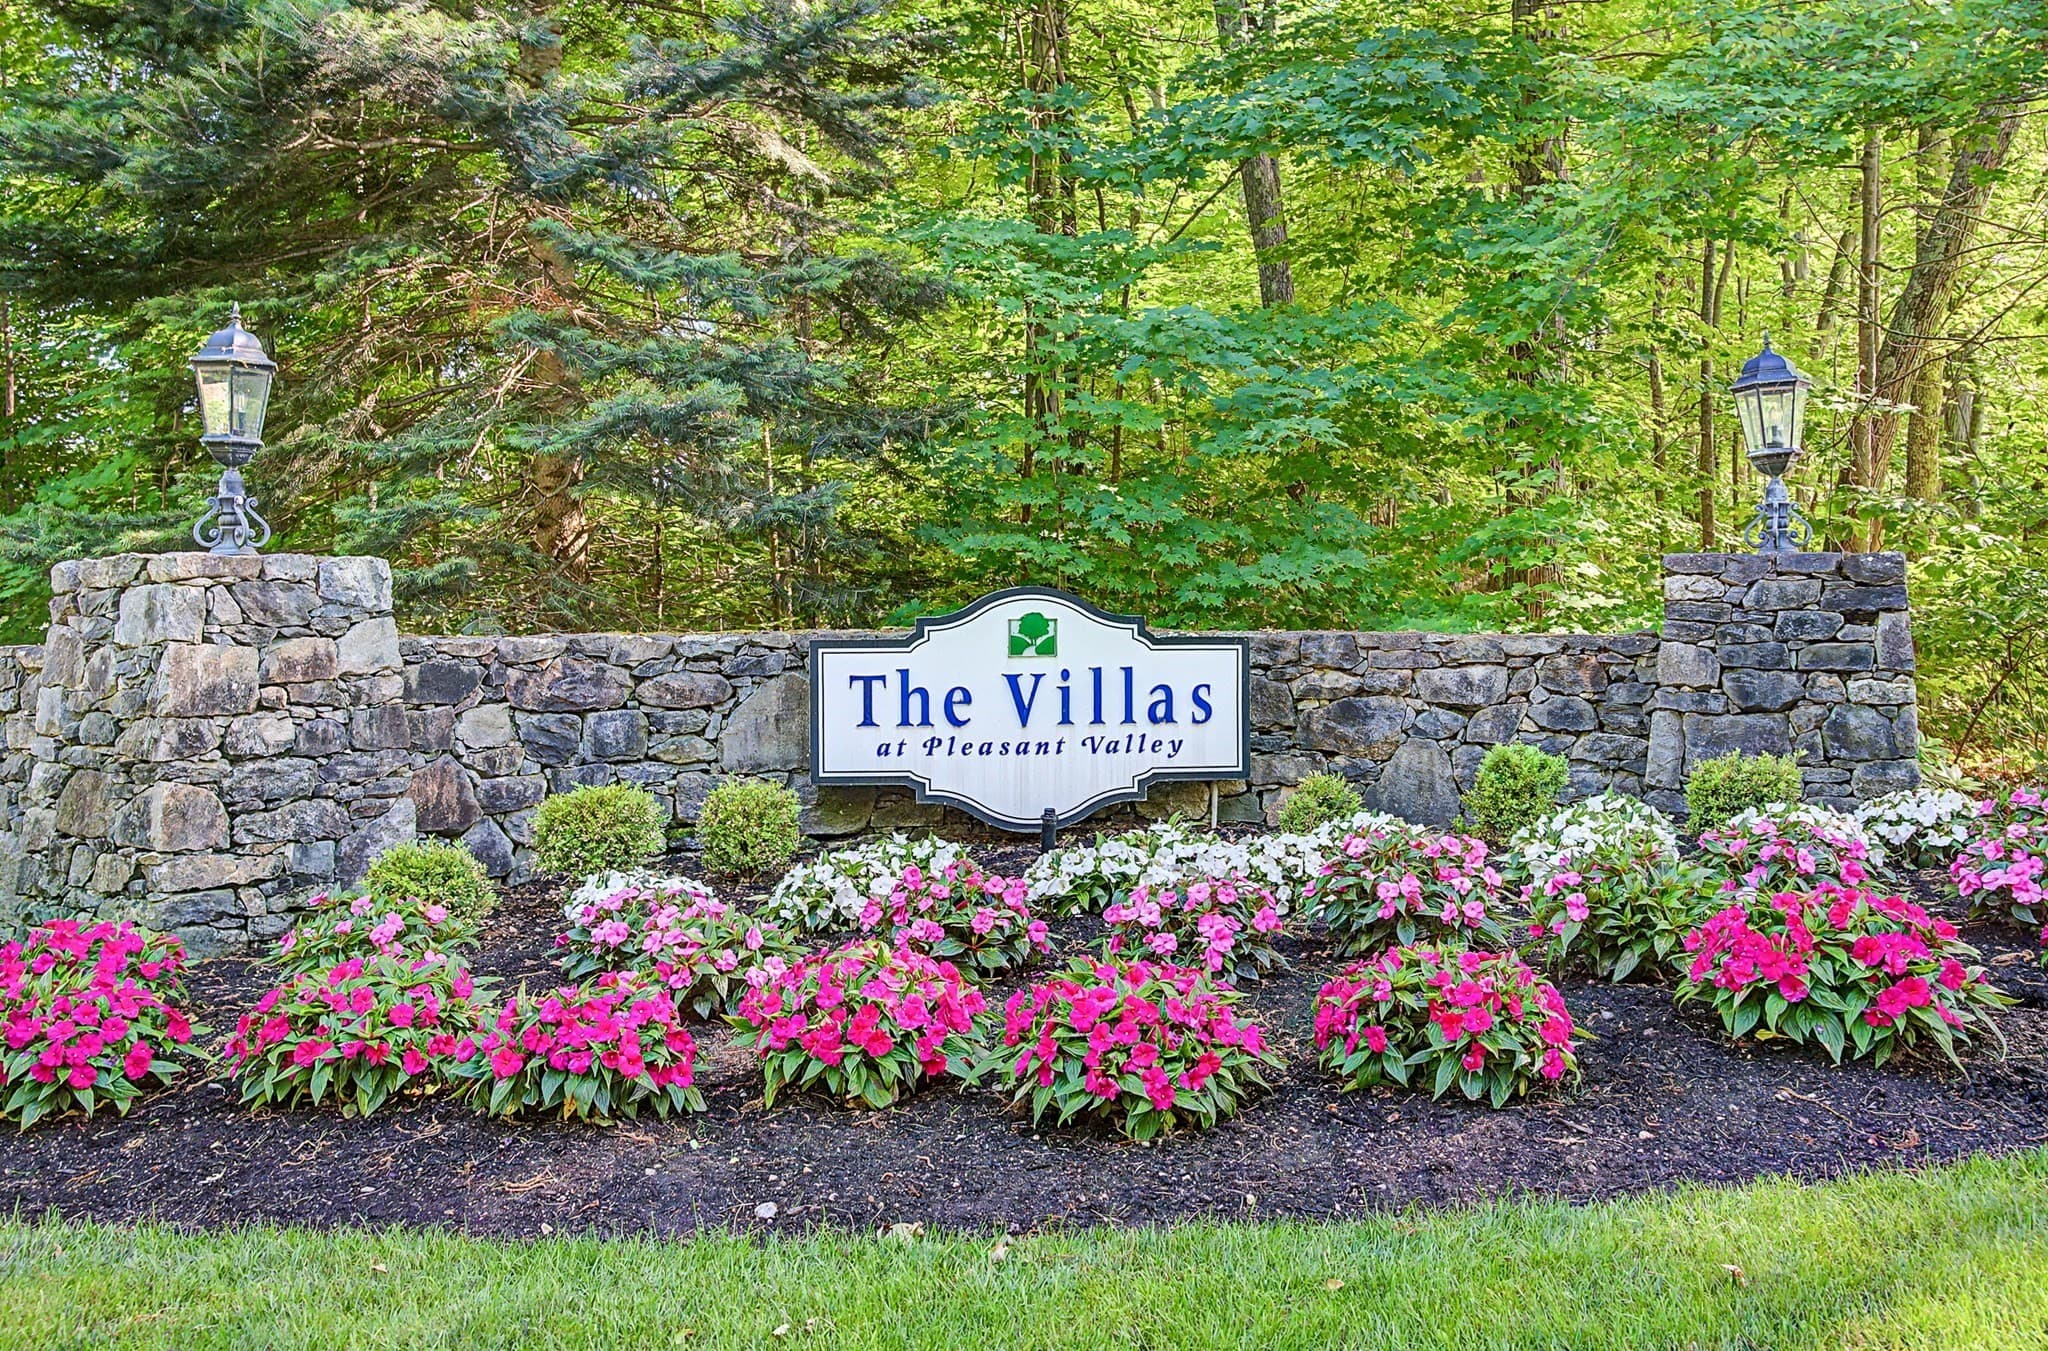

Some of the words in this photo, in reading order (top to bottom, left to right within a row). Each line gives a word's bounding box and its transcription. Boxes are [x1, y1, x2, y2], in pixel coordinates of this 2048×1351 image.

[849, 668, 973, 728] The
[1002, 666, 1213, 728] Villas
[876, 739, 907, 757] at
[922, 735, 1066, 757] Pleasant
[1081, 733, 1184, 758] Valley
